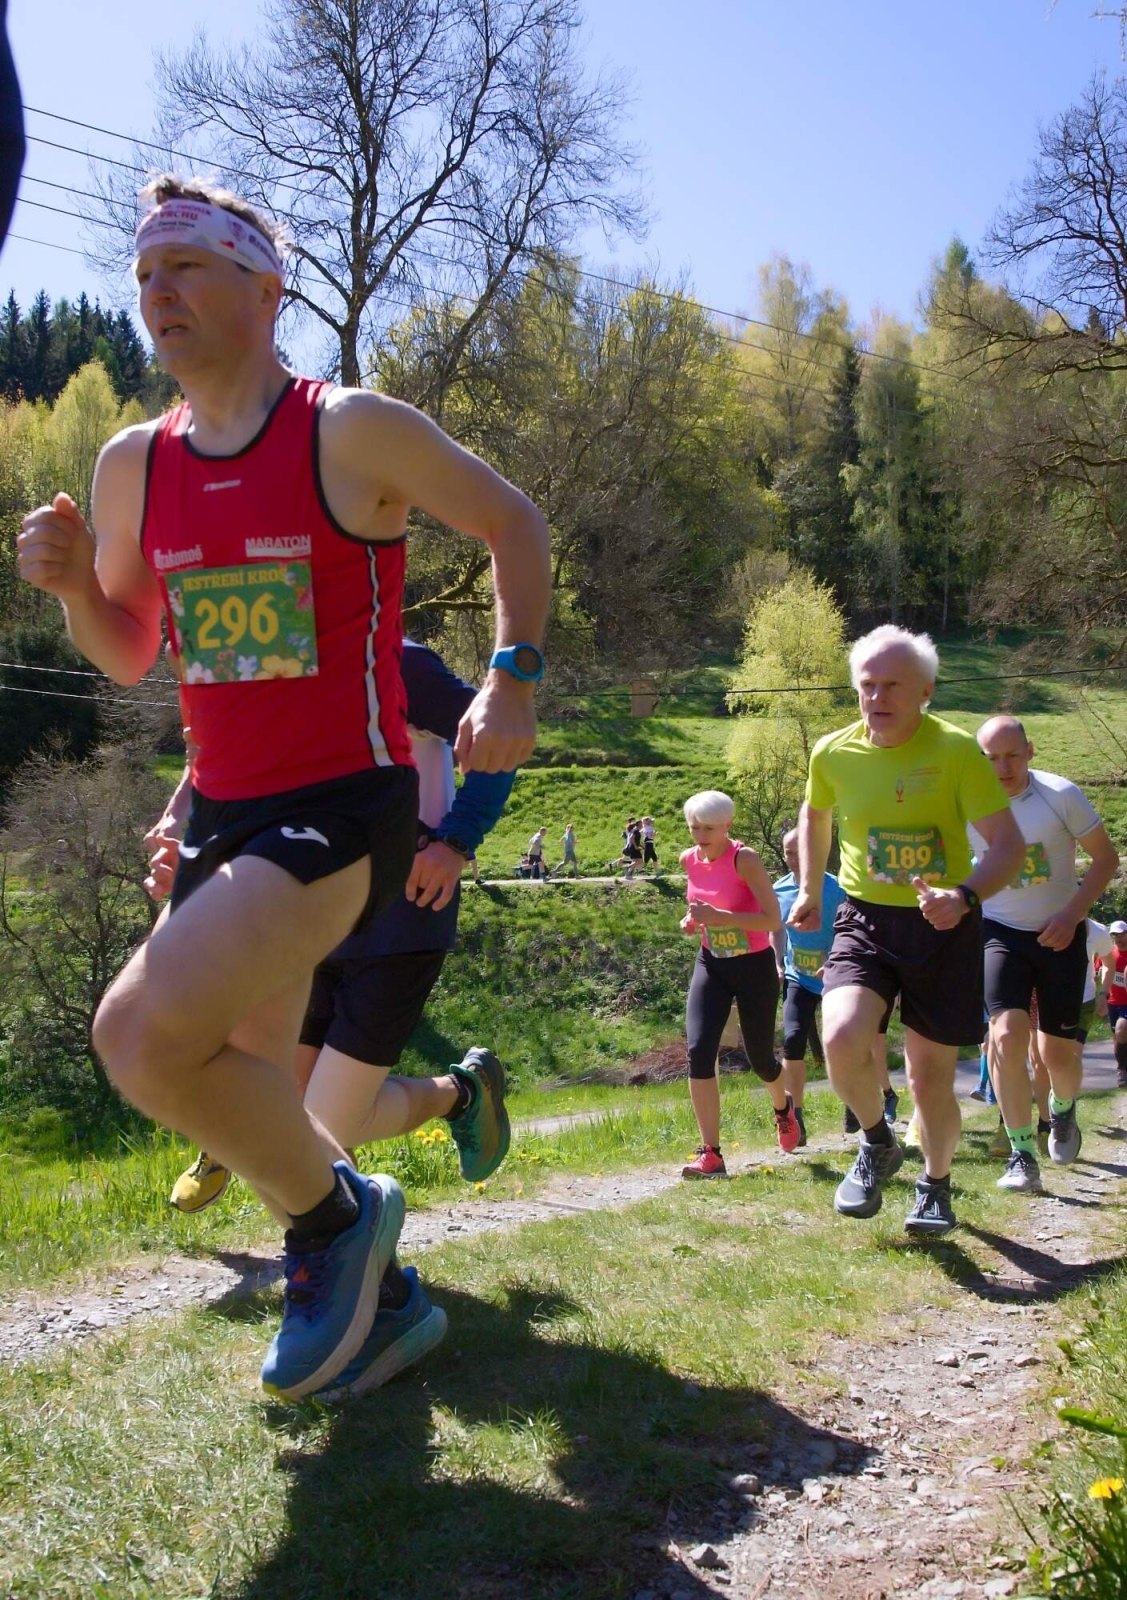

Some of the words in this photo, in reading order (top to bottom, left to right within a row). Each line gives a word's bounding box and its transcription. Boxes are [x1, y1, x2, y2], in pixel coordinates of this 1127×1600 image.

[245, 534, 311, 550] MARATON
[194, 592, 279, 649] 296
[885, 844, 933, 869] 189
[711, 931, 738, 948] 248
[797, 953, 818, 969] 104
